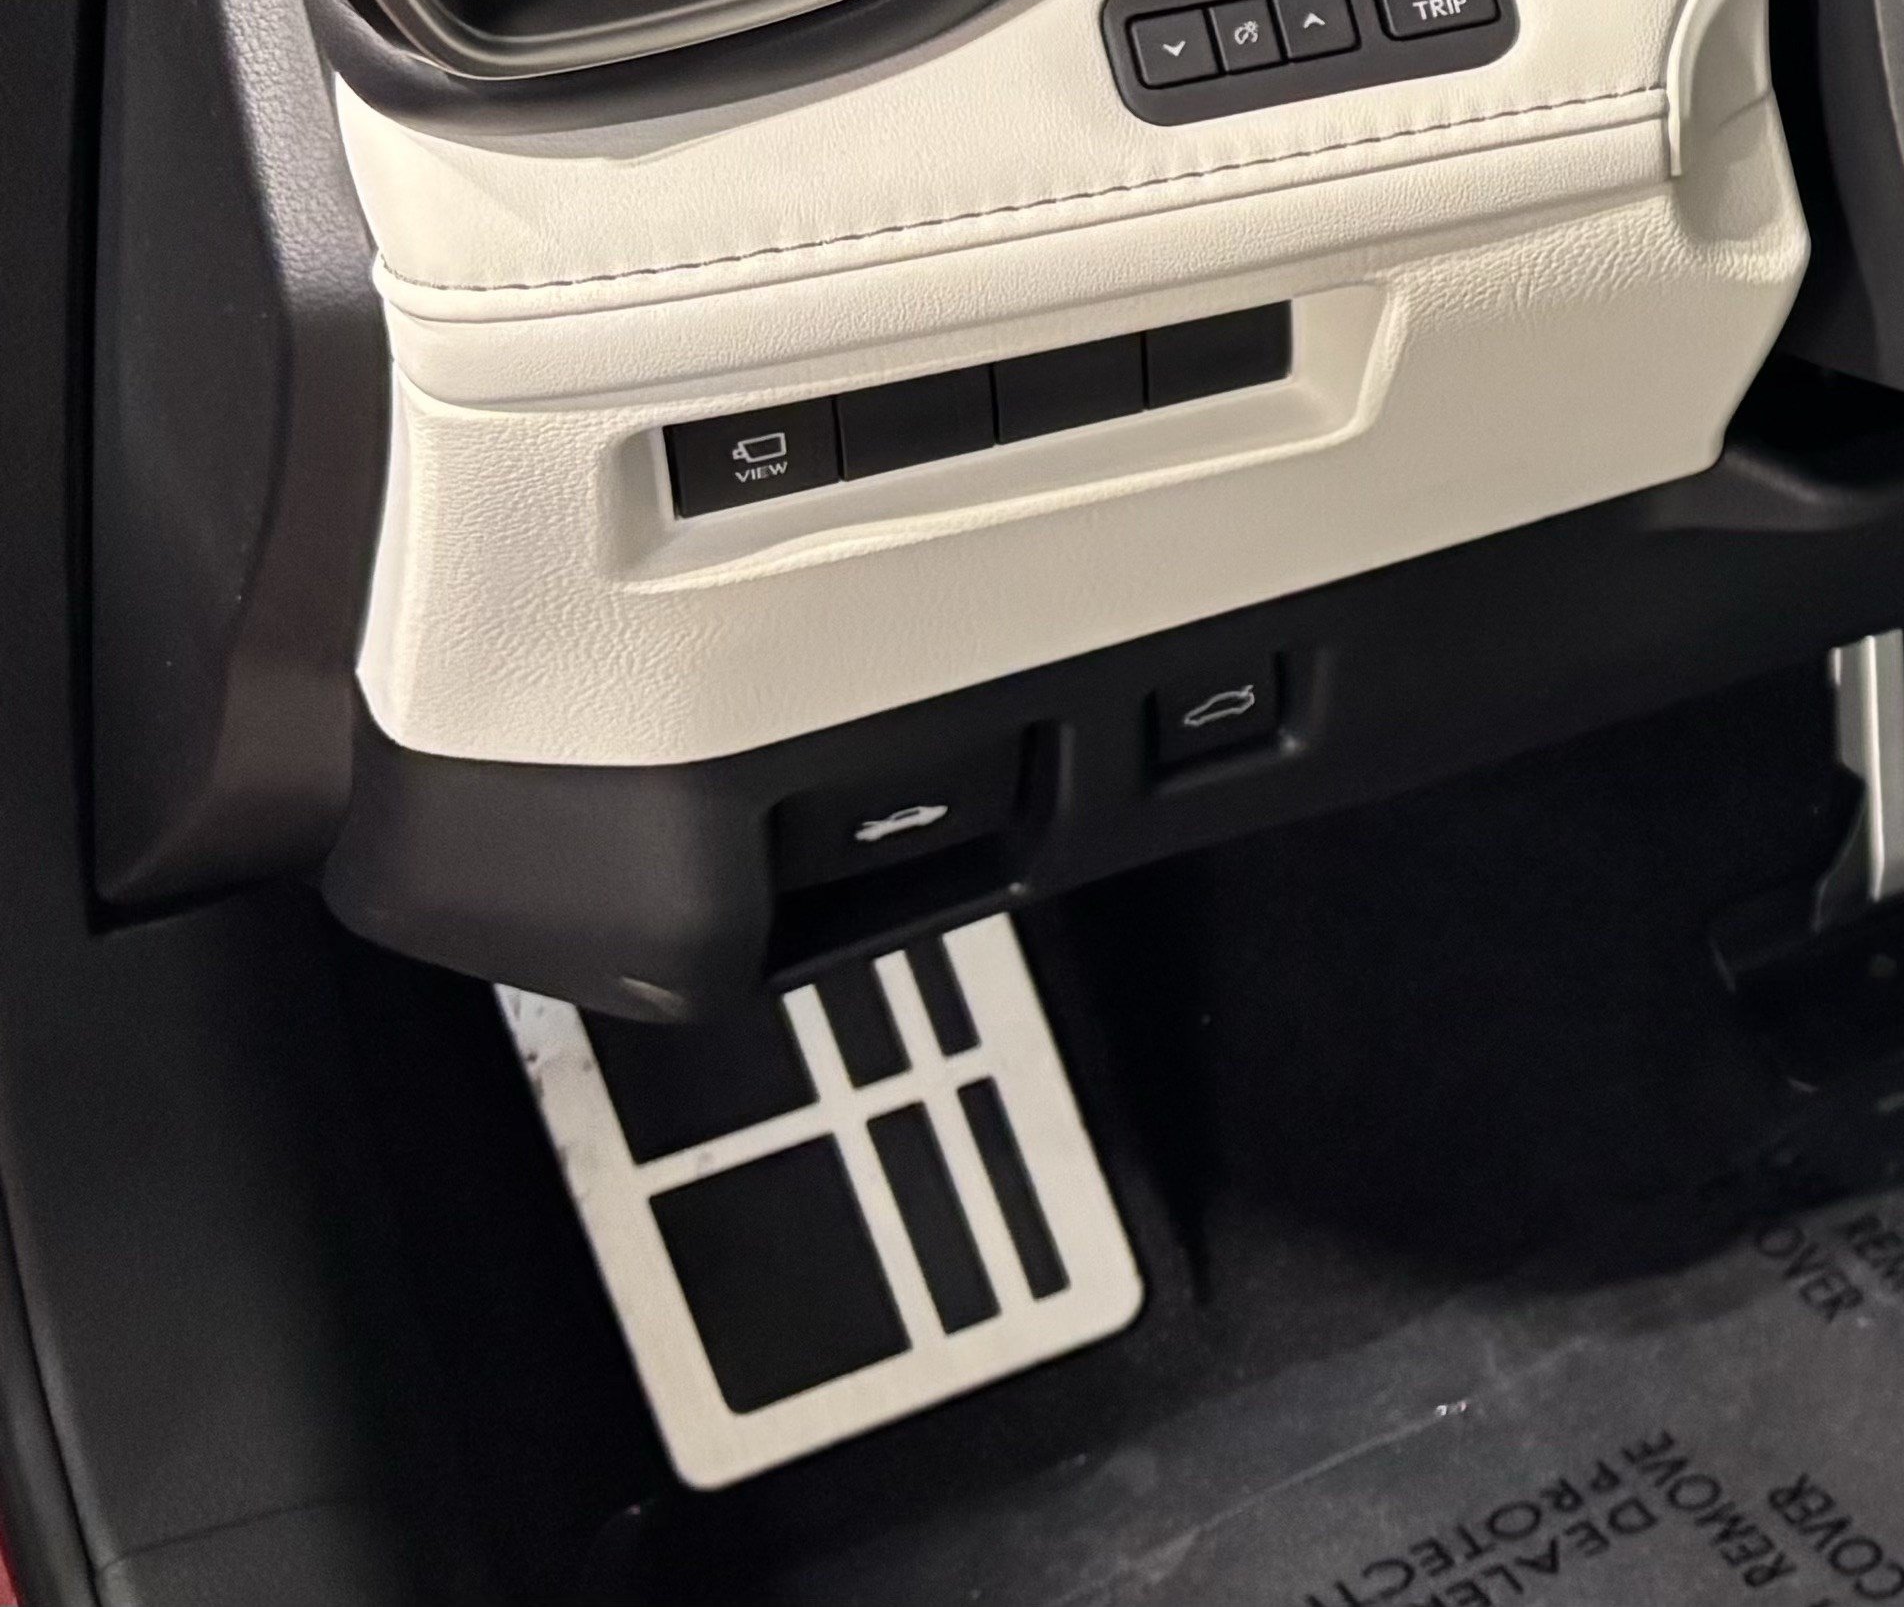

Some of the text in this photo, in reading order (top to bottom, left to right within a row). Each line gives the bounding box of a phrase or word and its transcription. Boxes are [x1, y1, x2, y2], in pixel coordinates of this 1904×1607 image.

[735, 461, 789, 484] VIEW
[1754, 1222, 1864, 1322] OVER
[1405, 1496, 1663, 1607] DEALE
[1619, 1427, 1799, 1591] REMOVE
